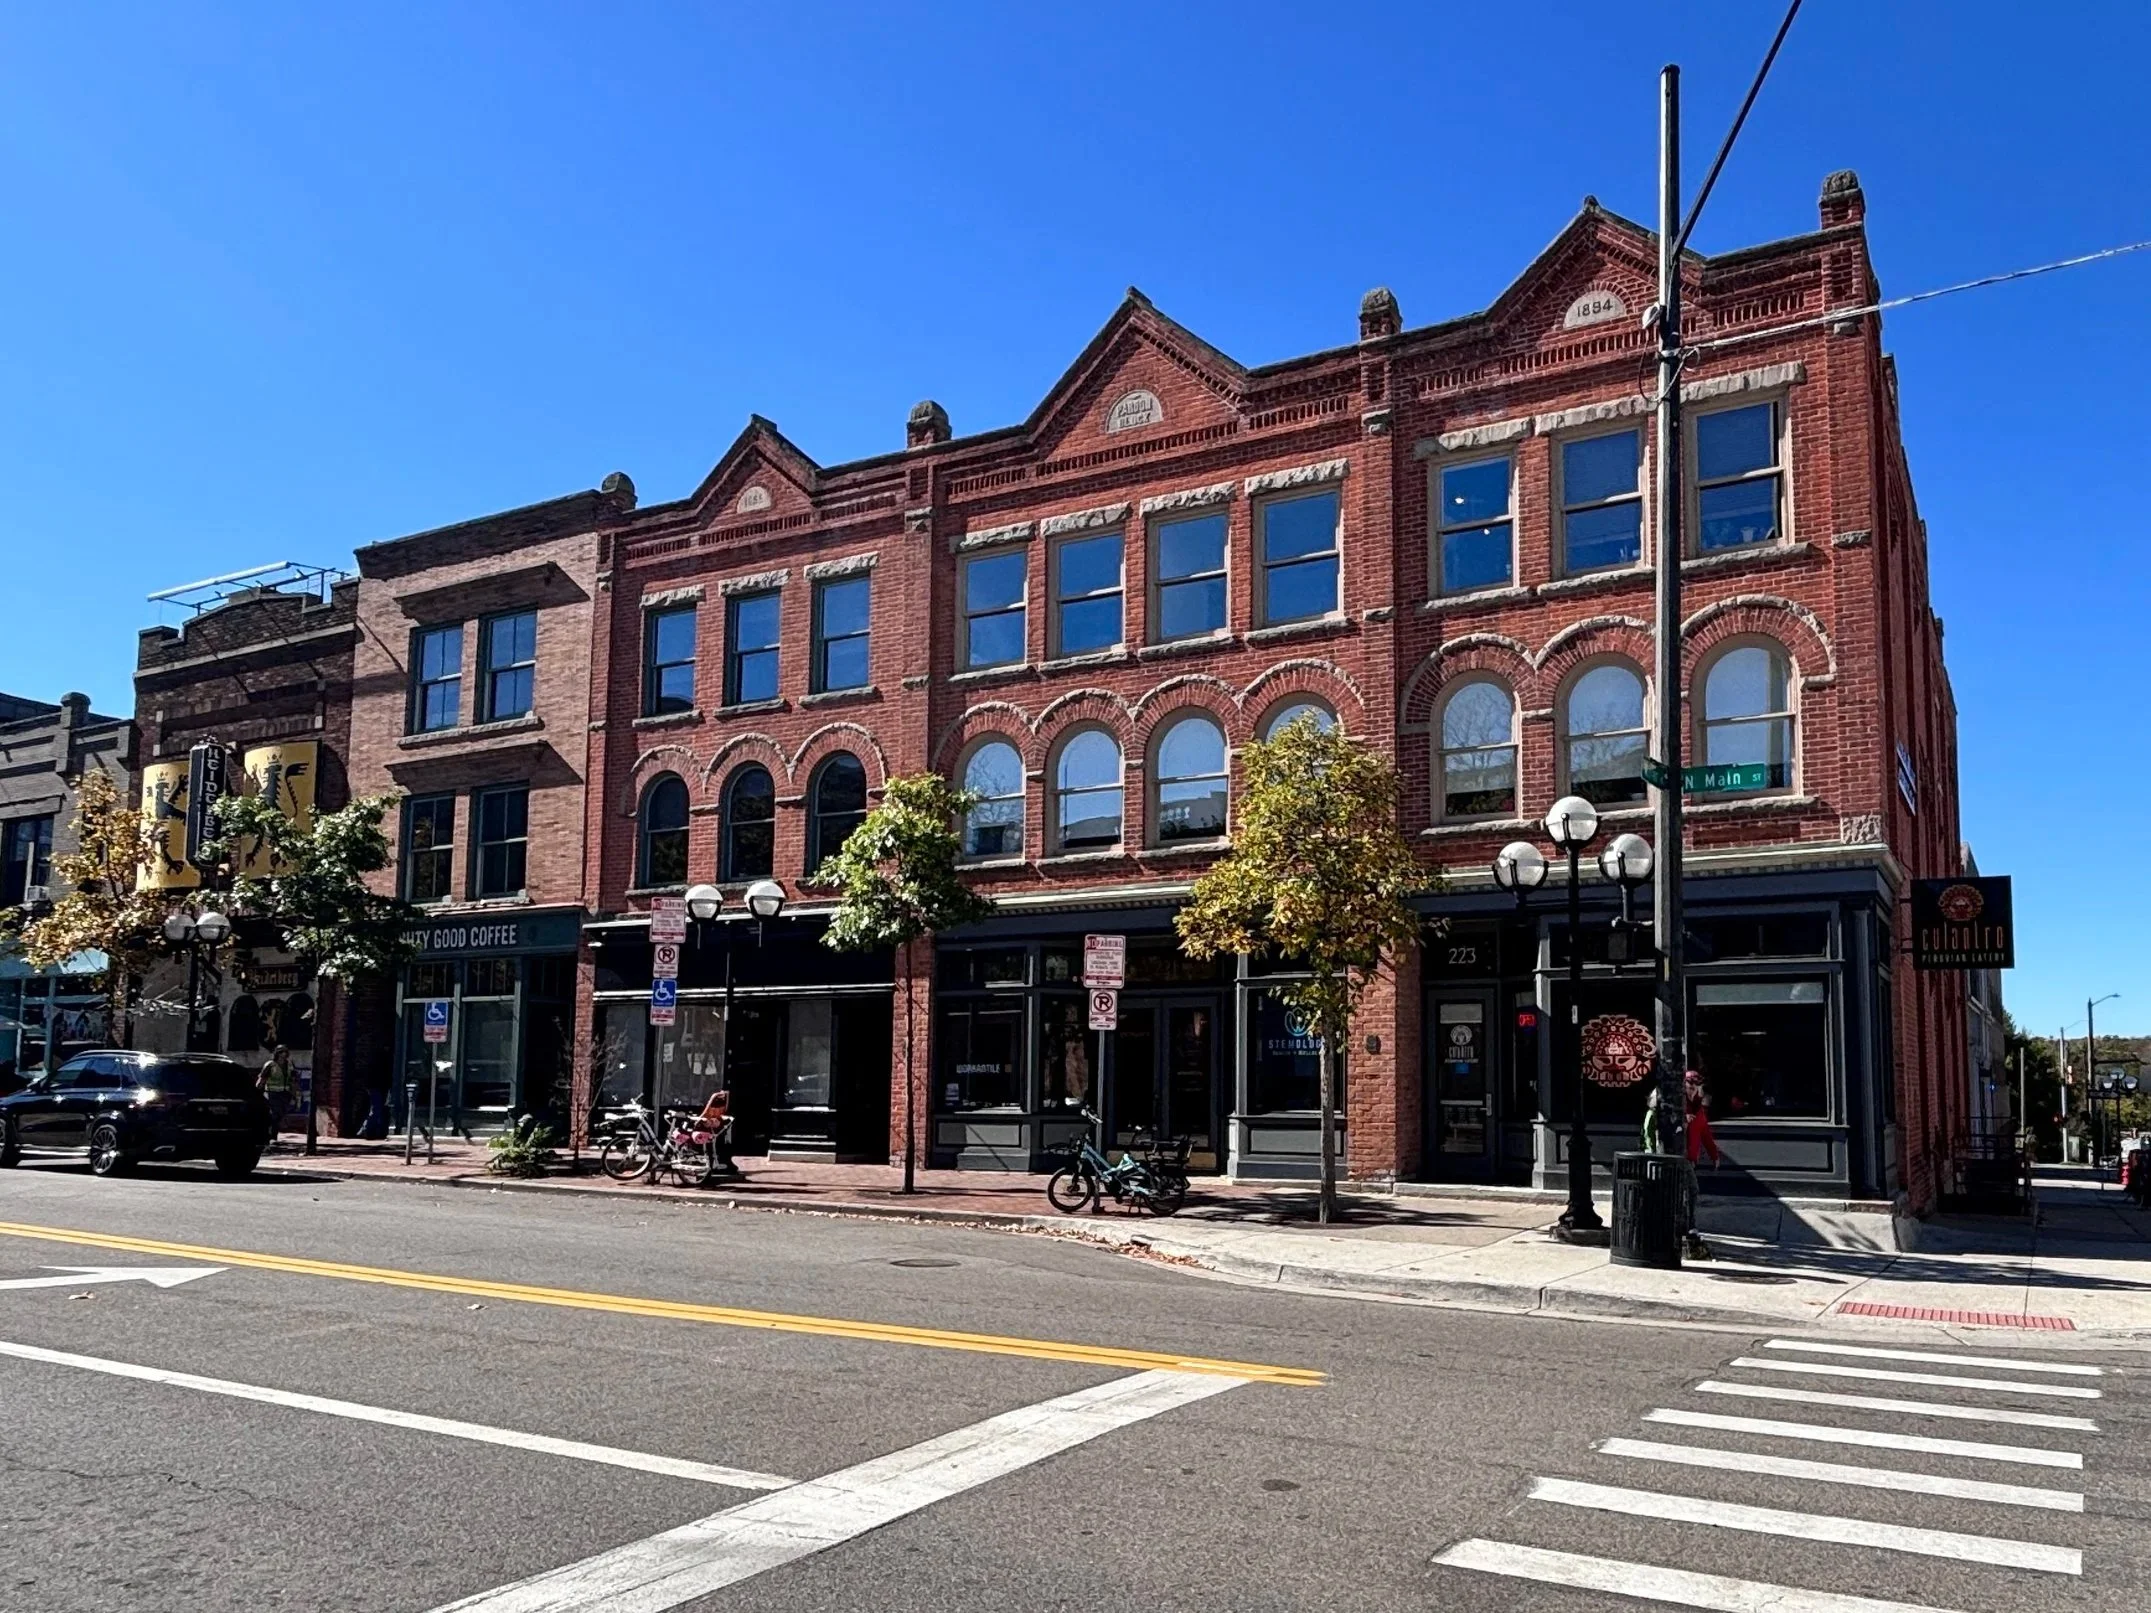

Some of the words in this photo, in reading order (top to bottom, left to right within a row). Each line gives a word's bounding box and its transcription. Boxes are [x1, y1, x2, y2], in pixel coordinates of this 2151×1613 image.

[1685, 775, 1694, 789] N
[1705, 771, 1741, 787] Main
[1752, 773, 1761, 782] ST
[433, 927, 466, 949] GOOD
[470, 924, 518, 947] COFFEE
[1448, 947, 1476, 964] 223
